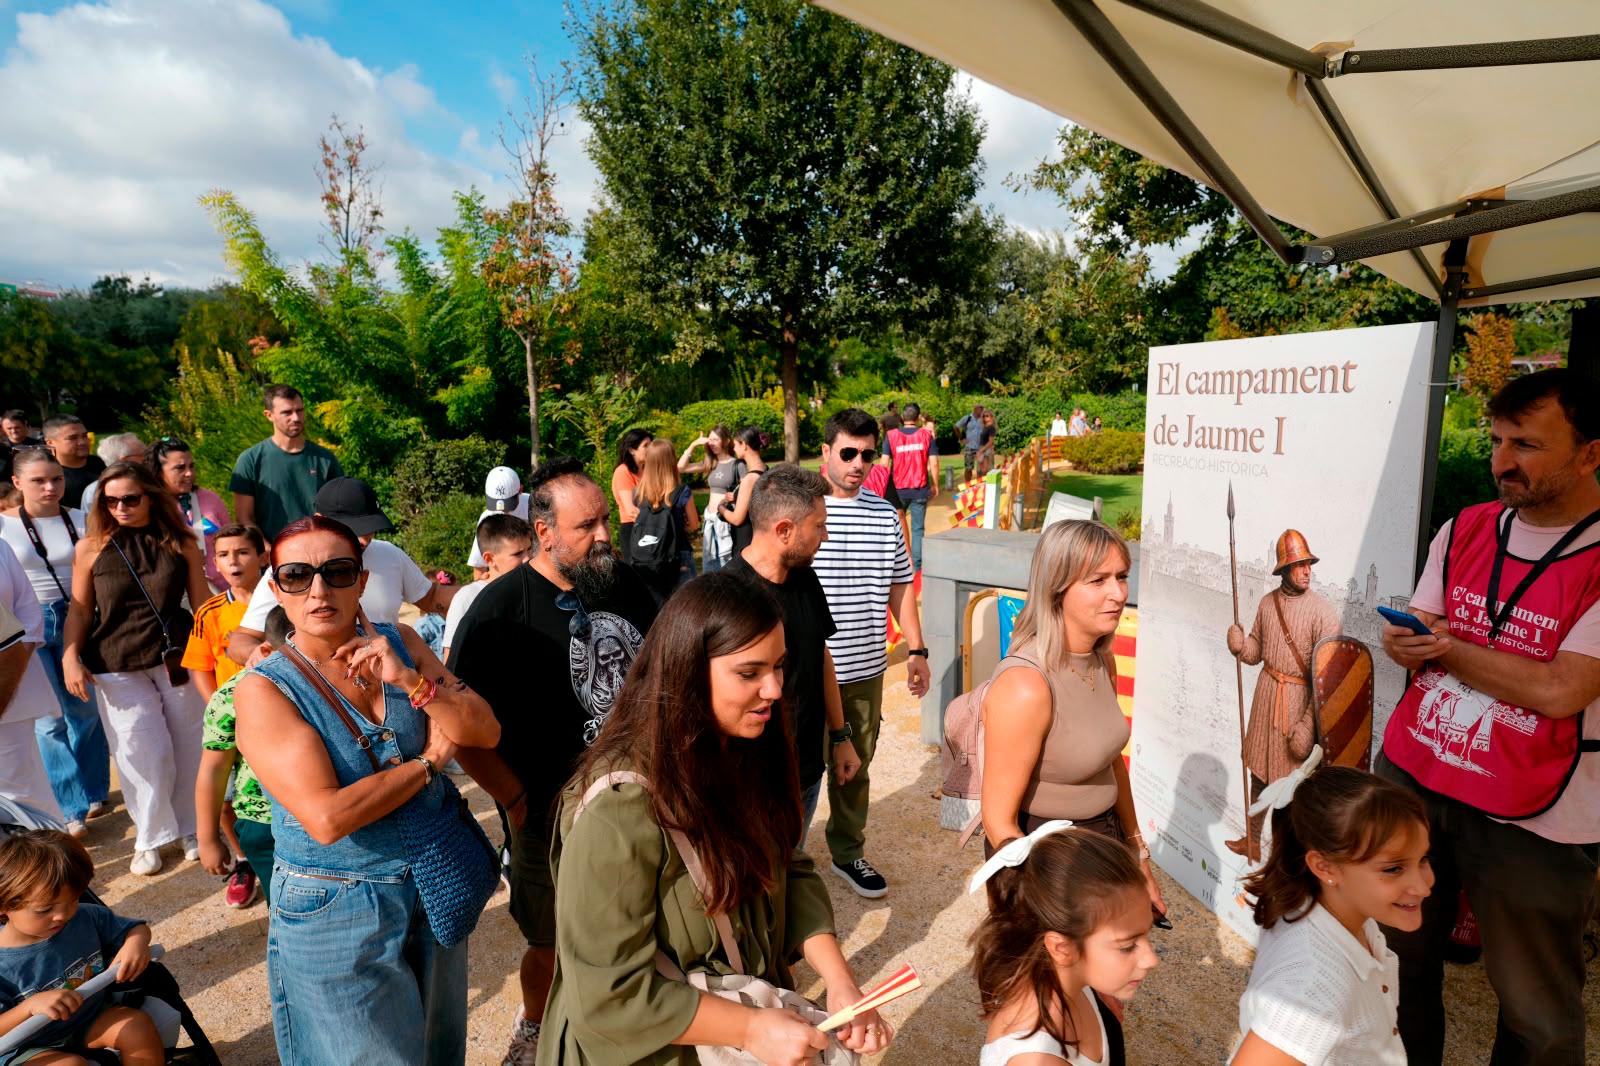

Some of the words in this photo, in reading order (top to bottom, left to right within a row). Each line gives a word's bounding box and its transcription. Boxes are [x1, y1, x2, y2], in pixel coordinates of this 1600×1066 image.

[1156, 362, 1180, 396] El
[1185, 359, 1358, 406] campament
[1153, 414, 1179, 446] de
[1183, 414, 1265, 454] Jaume
[1272, 416, 1287, 456] I
[1208, 456, 1269, 478] HISTÒRICA
[1454, 604, 1470, 620] de
[1473, 609, 1528, 639] Jame
[1532, 628, 1543, 644] I
[1465, 592, 1559, 632] caament
